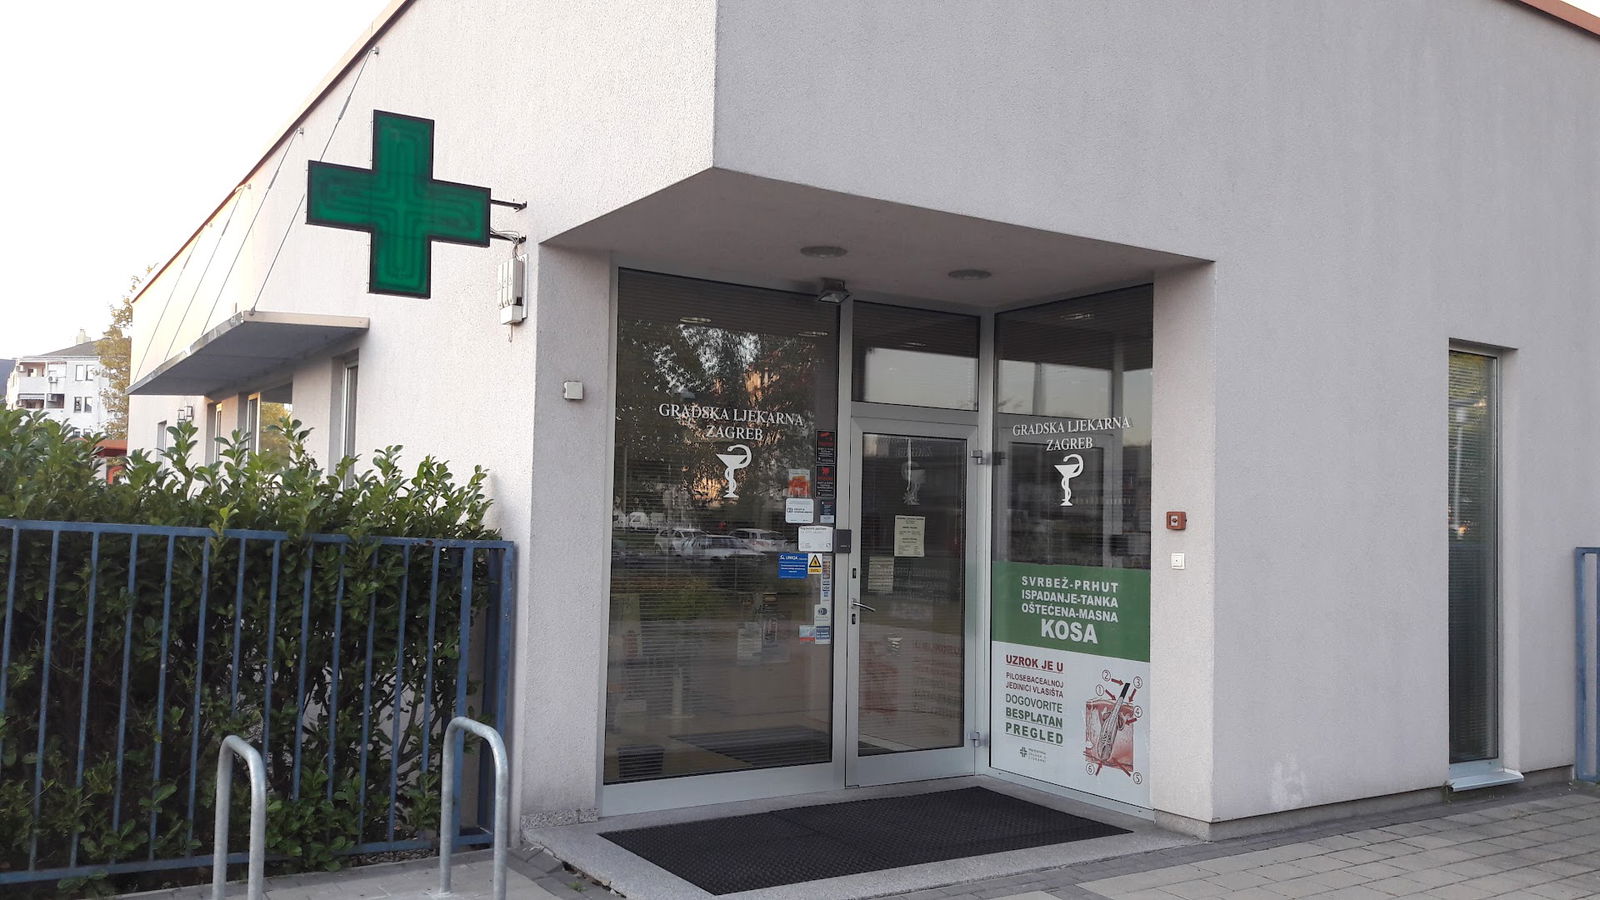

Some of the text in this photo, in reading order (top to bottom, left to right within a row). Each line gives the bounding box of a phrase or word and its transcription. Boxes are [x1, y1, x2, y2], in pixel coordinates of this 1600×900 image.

[658, 403, 804, 426] GRADSKA LJEKARNA
[706, 424, 763, 442] ZAGREB
[1012, 416, 1131, 437] GRADSKA LJEKARNA
[1046, 437, 1093, 452] ZAGREB
[1021, 575, 1119, 593] SVRBEŽ-PRHUT
[1021, 589, 1119, 608] ISPADANJE-TANKA
[1021, 602, 1119, 623] OŠTEĆENA-MASNA
[1041, 618, 1098, 644] KOSA
[1005, 654, 1064, 672] UZROK JE U
[1005, 672, 1064, 688] PILOSEBACEALNOJ
[1005, 681, 1064, 698] JEDINICI VLASIŠTA
[1005, 693, 1063, 714] DOGOVORITE
[1005, 707, 1063, 728] BESPLATAN
[1005, 722, 1064, 744] PREGLED
